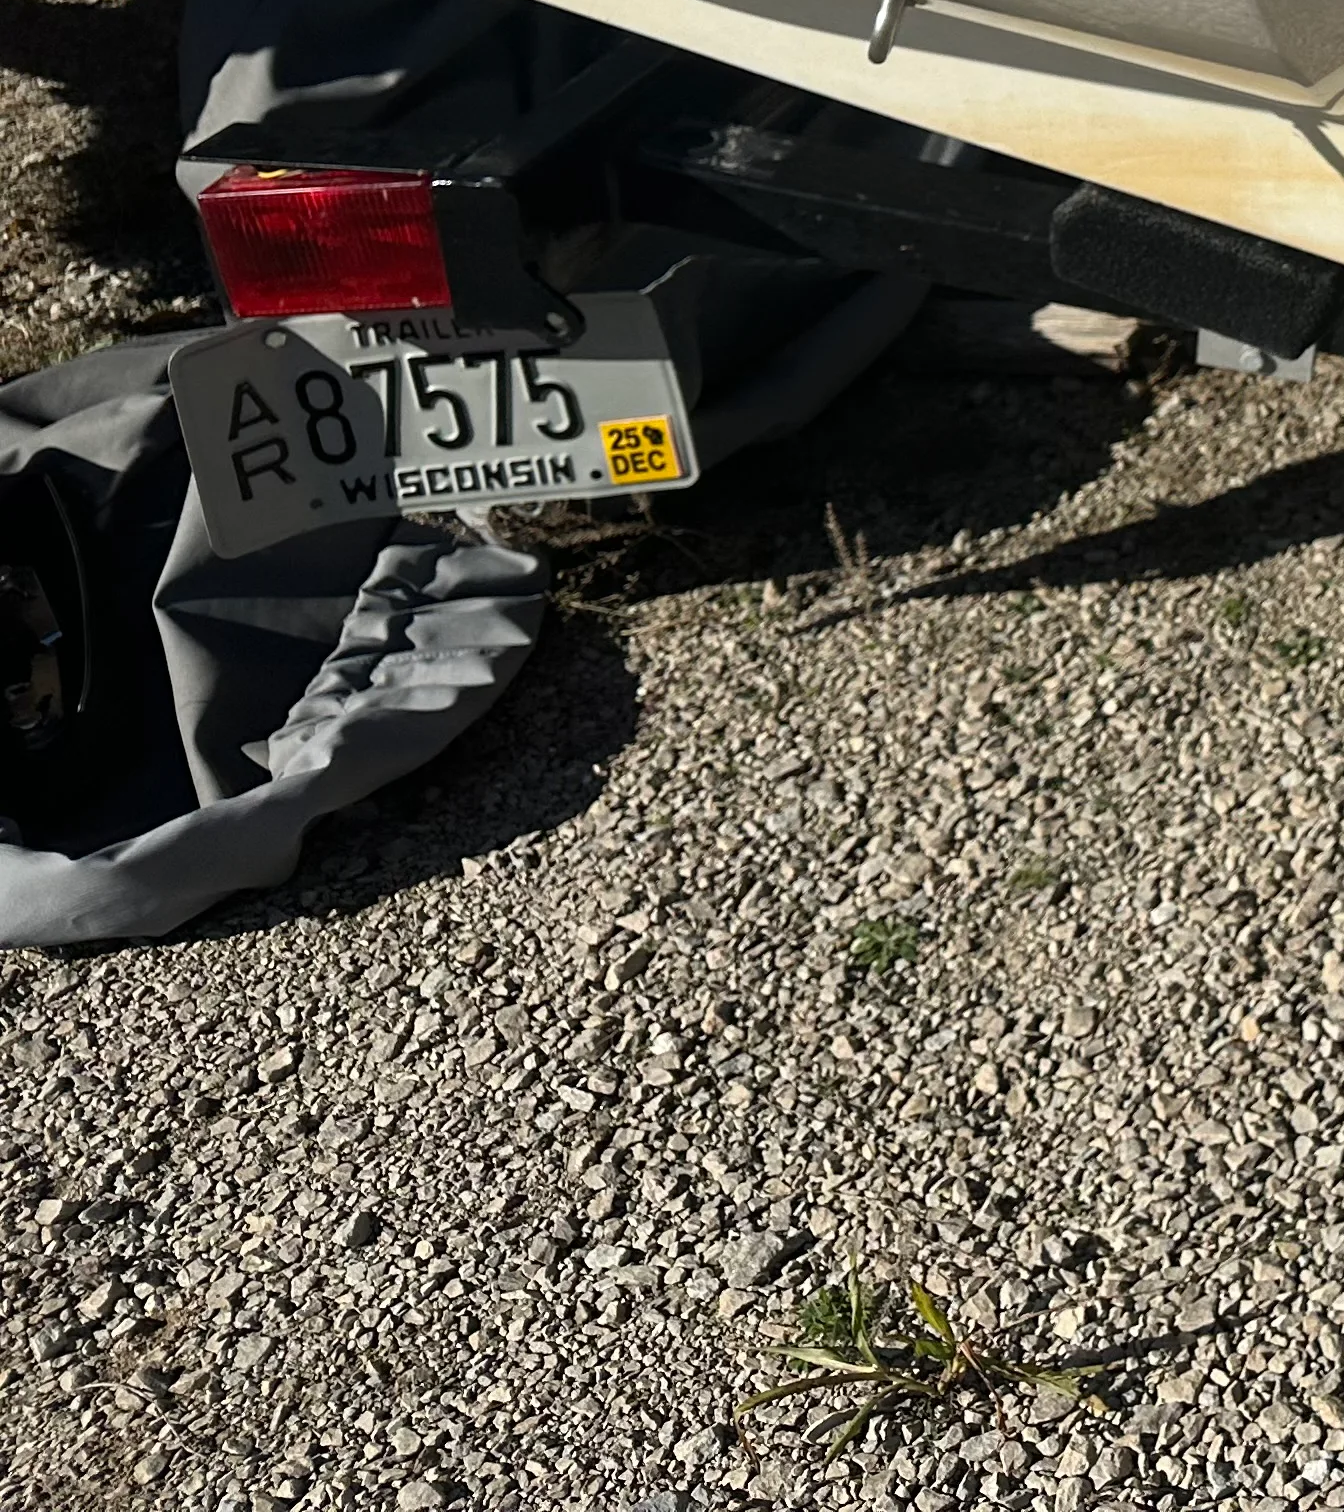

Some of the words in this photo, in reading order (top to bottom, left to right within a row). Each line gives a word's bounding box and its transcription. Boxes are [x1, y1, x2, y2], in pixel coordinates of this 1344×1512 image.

[295, 348, 584, 465] 87575
[608, 426, 641, 451] 25
[340, 454, 576, 505] WISCONSIN
[611, 450, 666, 476] DEC
